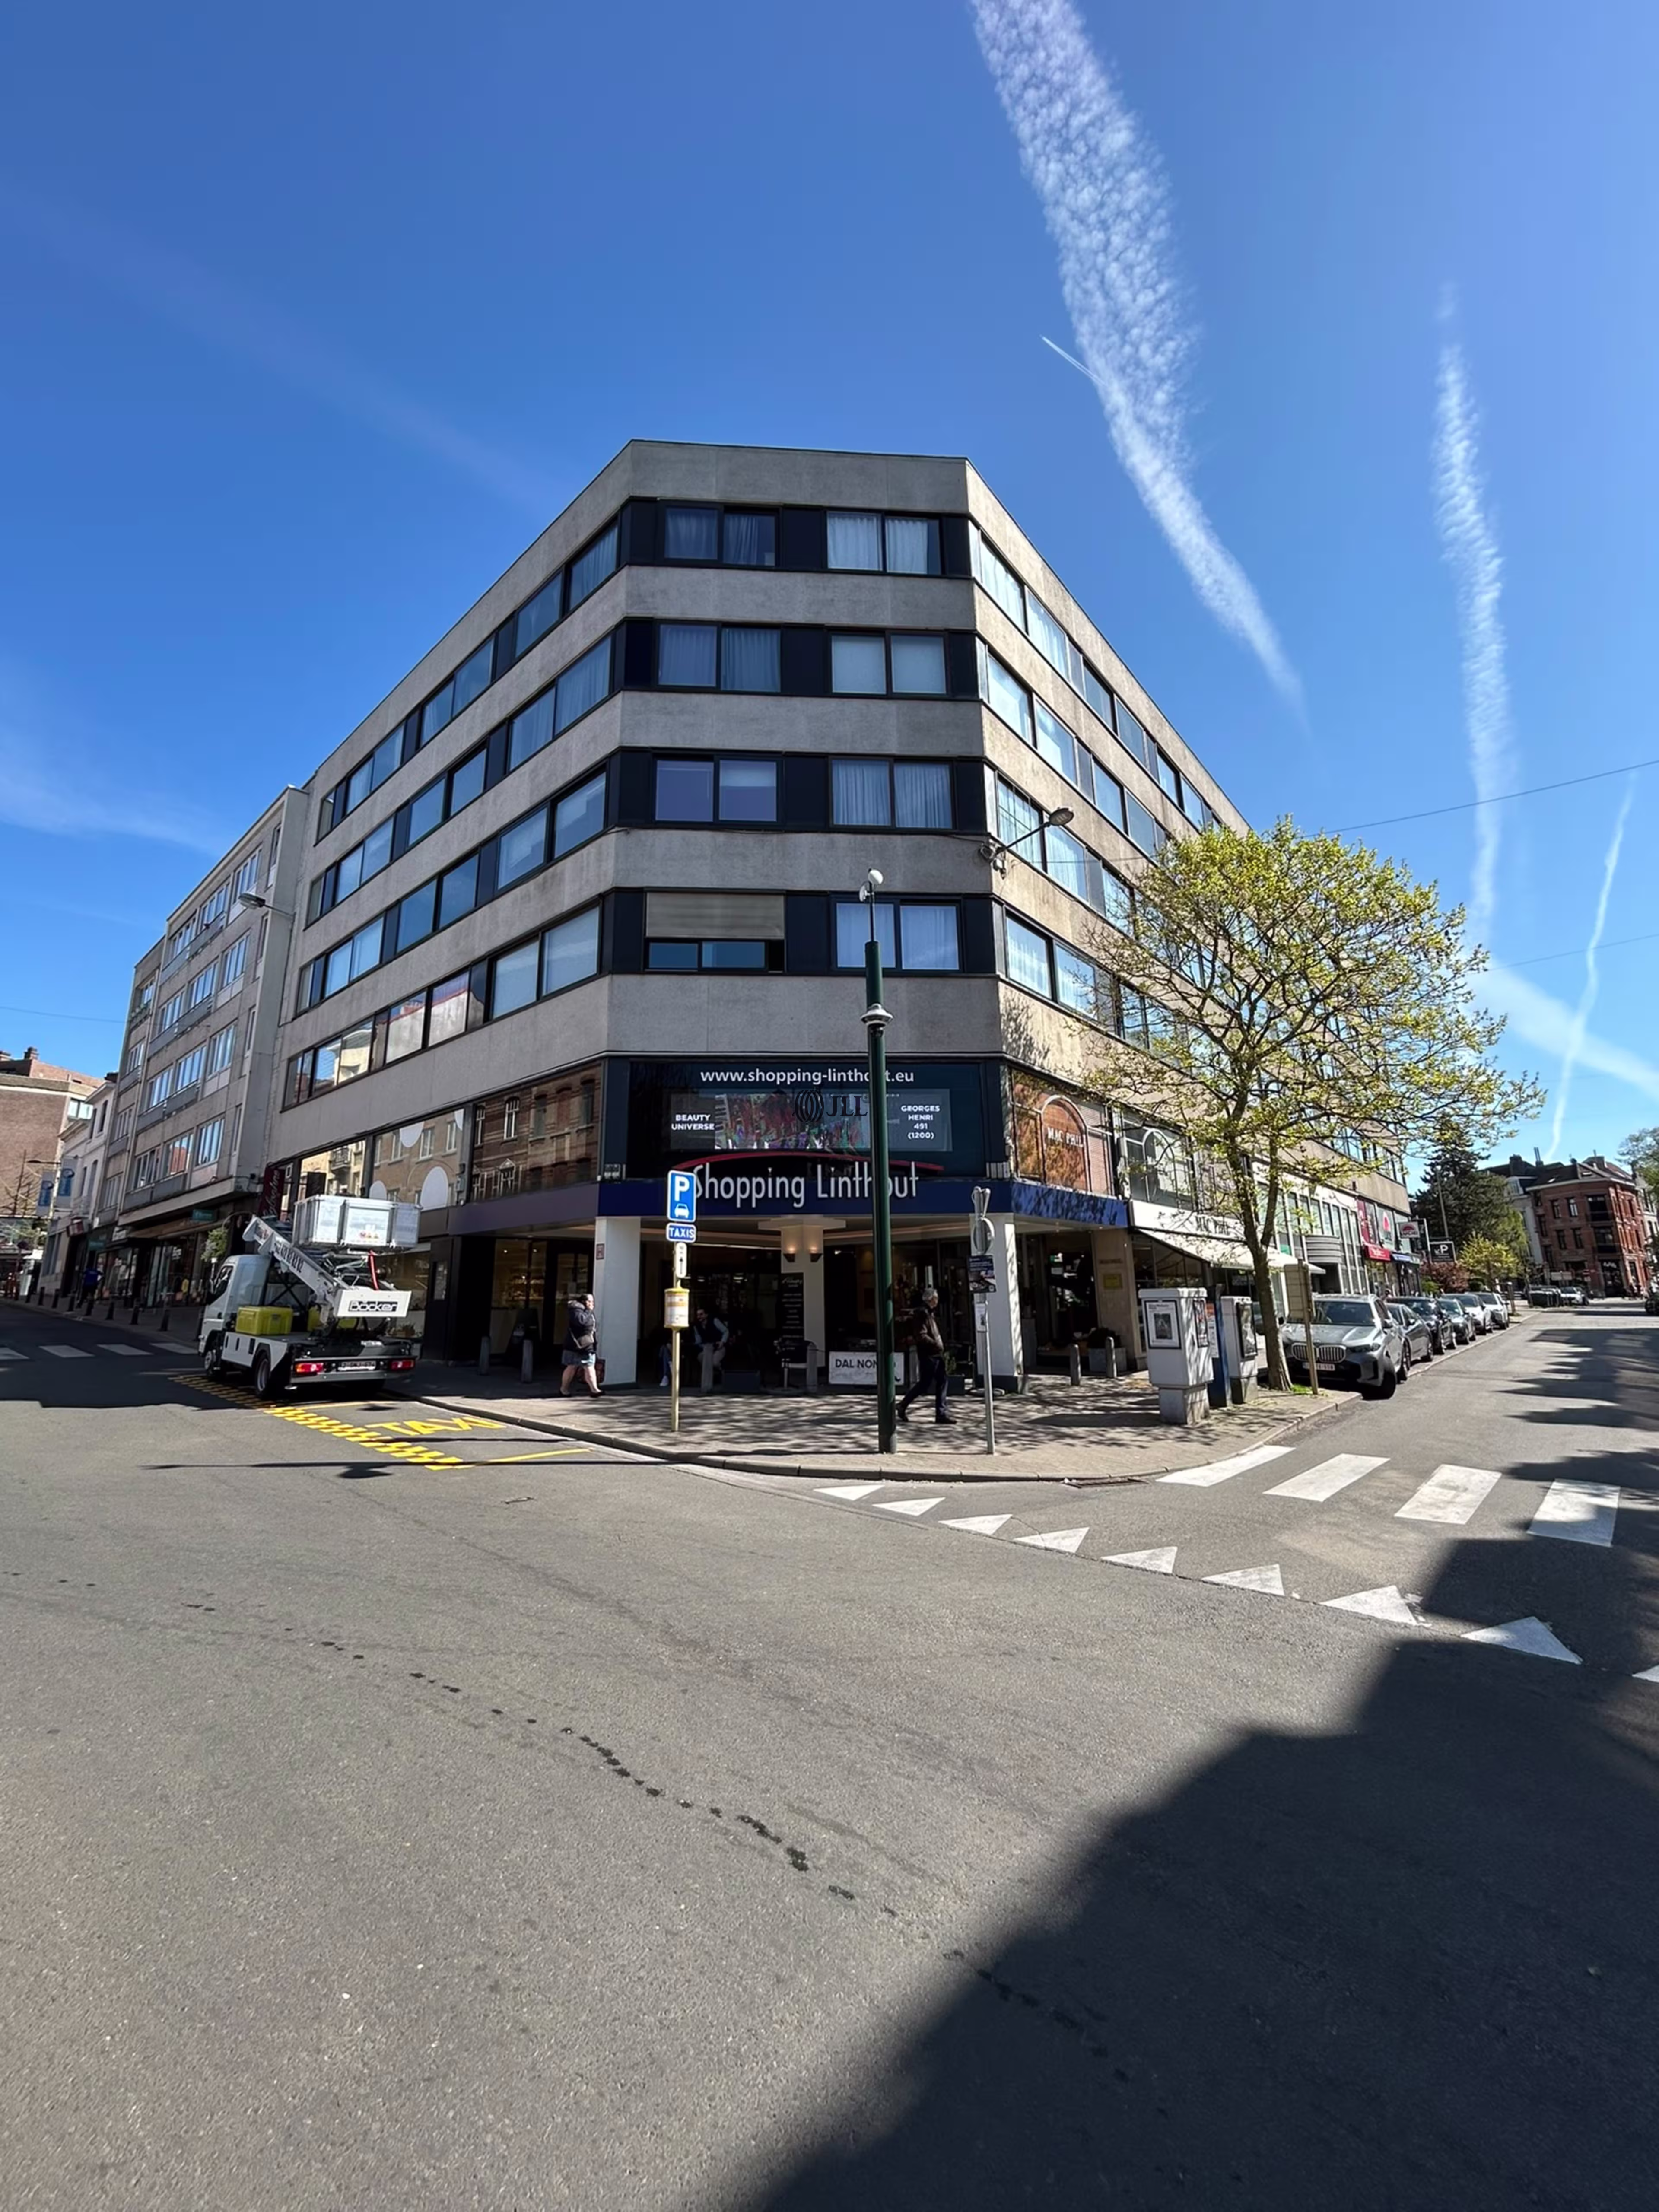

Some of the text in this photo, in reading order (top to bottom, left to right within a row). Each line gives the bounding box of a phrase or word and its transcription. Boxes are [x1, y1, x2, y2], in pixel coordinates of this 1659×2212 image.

[700, 1068, 914, 1085] www.shopping-linthot.eu
[674, 1176, 690, 1201] P
[693, 1162, 805, 1208] Shopping
[669, 1228, 695, 1238] TAXIS
[835, 1359, 855, 1368] DAL
